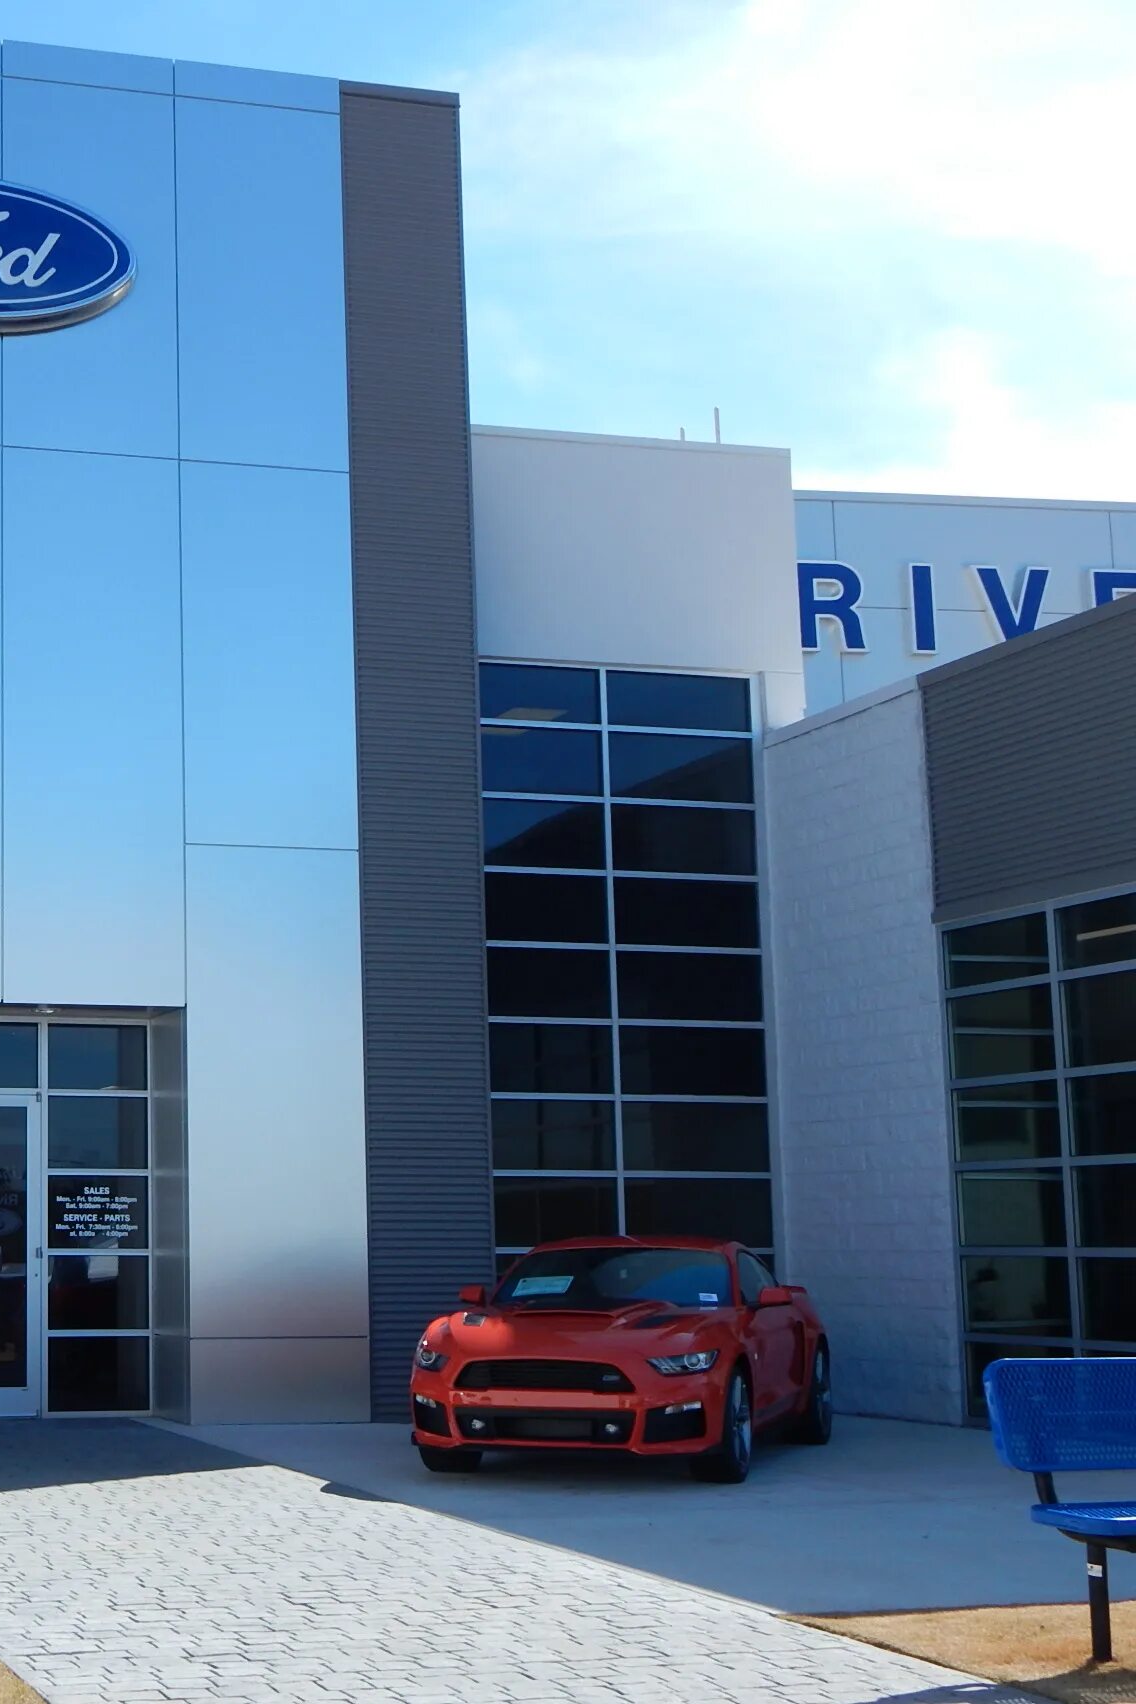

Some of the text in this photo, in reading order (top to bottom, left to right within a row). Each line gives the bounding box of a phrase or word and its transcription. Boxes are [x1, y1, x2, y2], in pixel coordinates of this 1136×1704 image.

[83, 1186, 110, 1195] SALES
[63, 1213, 98, 1222] SERVICE
[104, 1214, 131, 1222] PARTS
